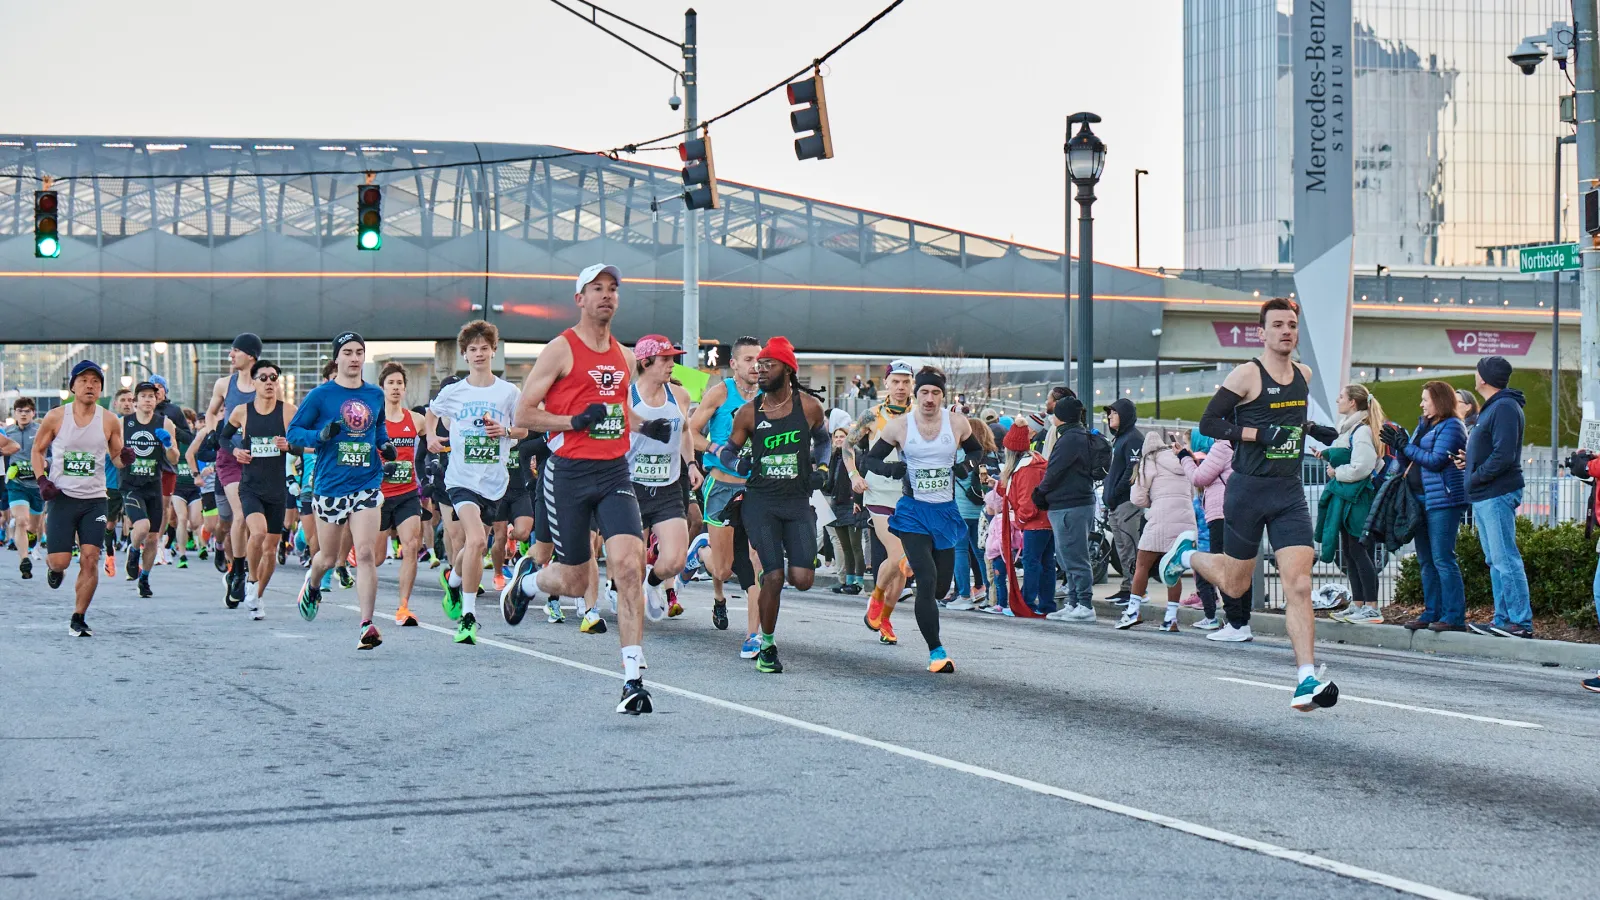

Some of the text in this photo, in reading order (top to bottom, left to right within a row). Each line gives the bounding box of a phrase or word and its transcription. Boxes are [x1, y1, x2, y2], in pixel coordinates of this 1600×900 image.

[1305, 0, 1326, 194] Mercedes-Benz
[1332, 44, 1343, 152] STADIUM
[1521, 250, 1565, 270] Northside
[603, 373, 612, 384] P
[764, 430, 801, 450] GFTC
[468, 448, 495, 456] A775
[342, 453, 366, 463] A351
[67, 462, 91, 470] A678
[635, 467, 668, 475] A5811
[766, 466, 794, 476] A636
[392, 470, 410, 478] 527
[917, 479, 949, 489] A5836
